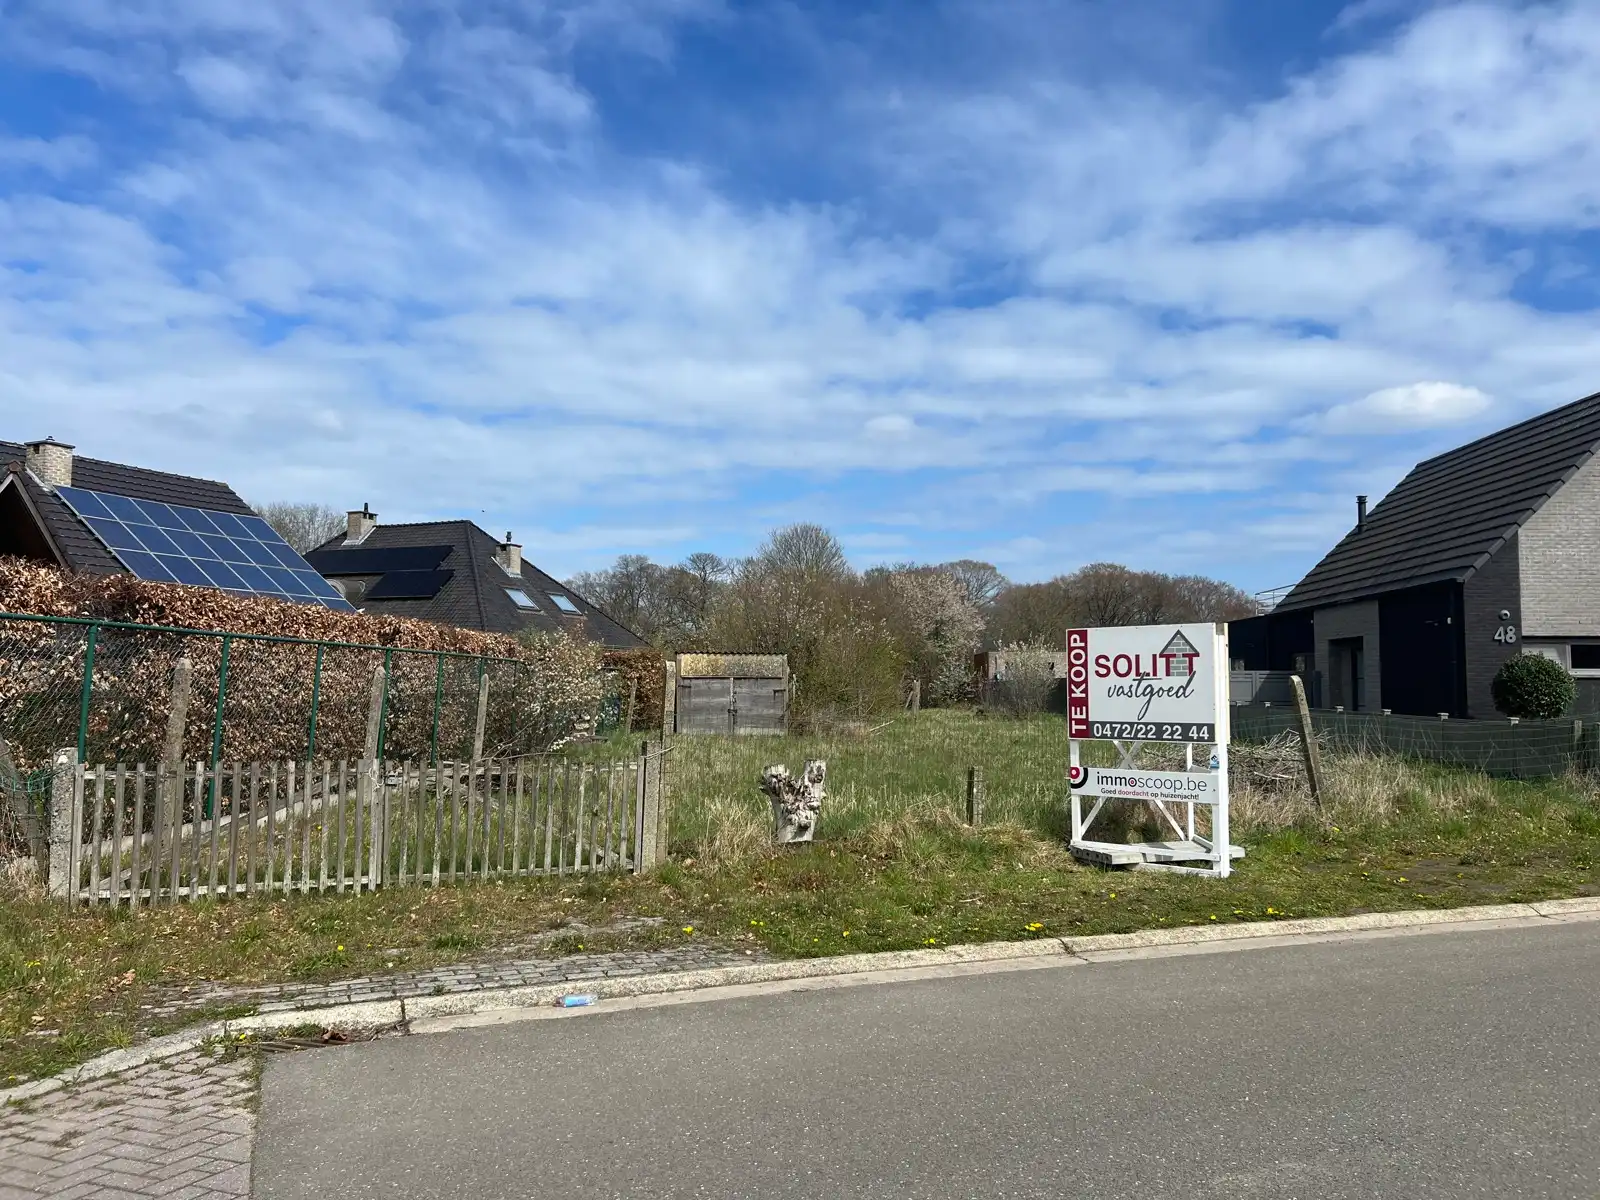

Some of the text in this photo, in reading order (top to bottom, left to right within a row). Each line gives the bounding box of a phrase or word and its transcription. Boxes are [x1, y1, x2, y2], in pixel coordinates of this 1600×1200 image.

[1494, 625, 1517, 643] 48
[1094, 653, 1200, 678] SOLITT
[1070, 634, 1087, 734] TE KOOP
[1107, 671, 1197, 721] vastgoed
[1093, 723, 1209, 740] 0472/22 22 44
[1096, 771, 1208, 793] immoscoop.be
[1100, 787, 1117, 795] Goed
[1117, 788, 1149, 797] doordacht
[1160, 791, 1200, 800] huizenjacht!
